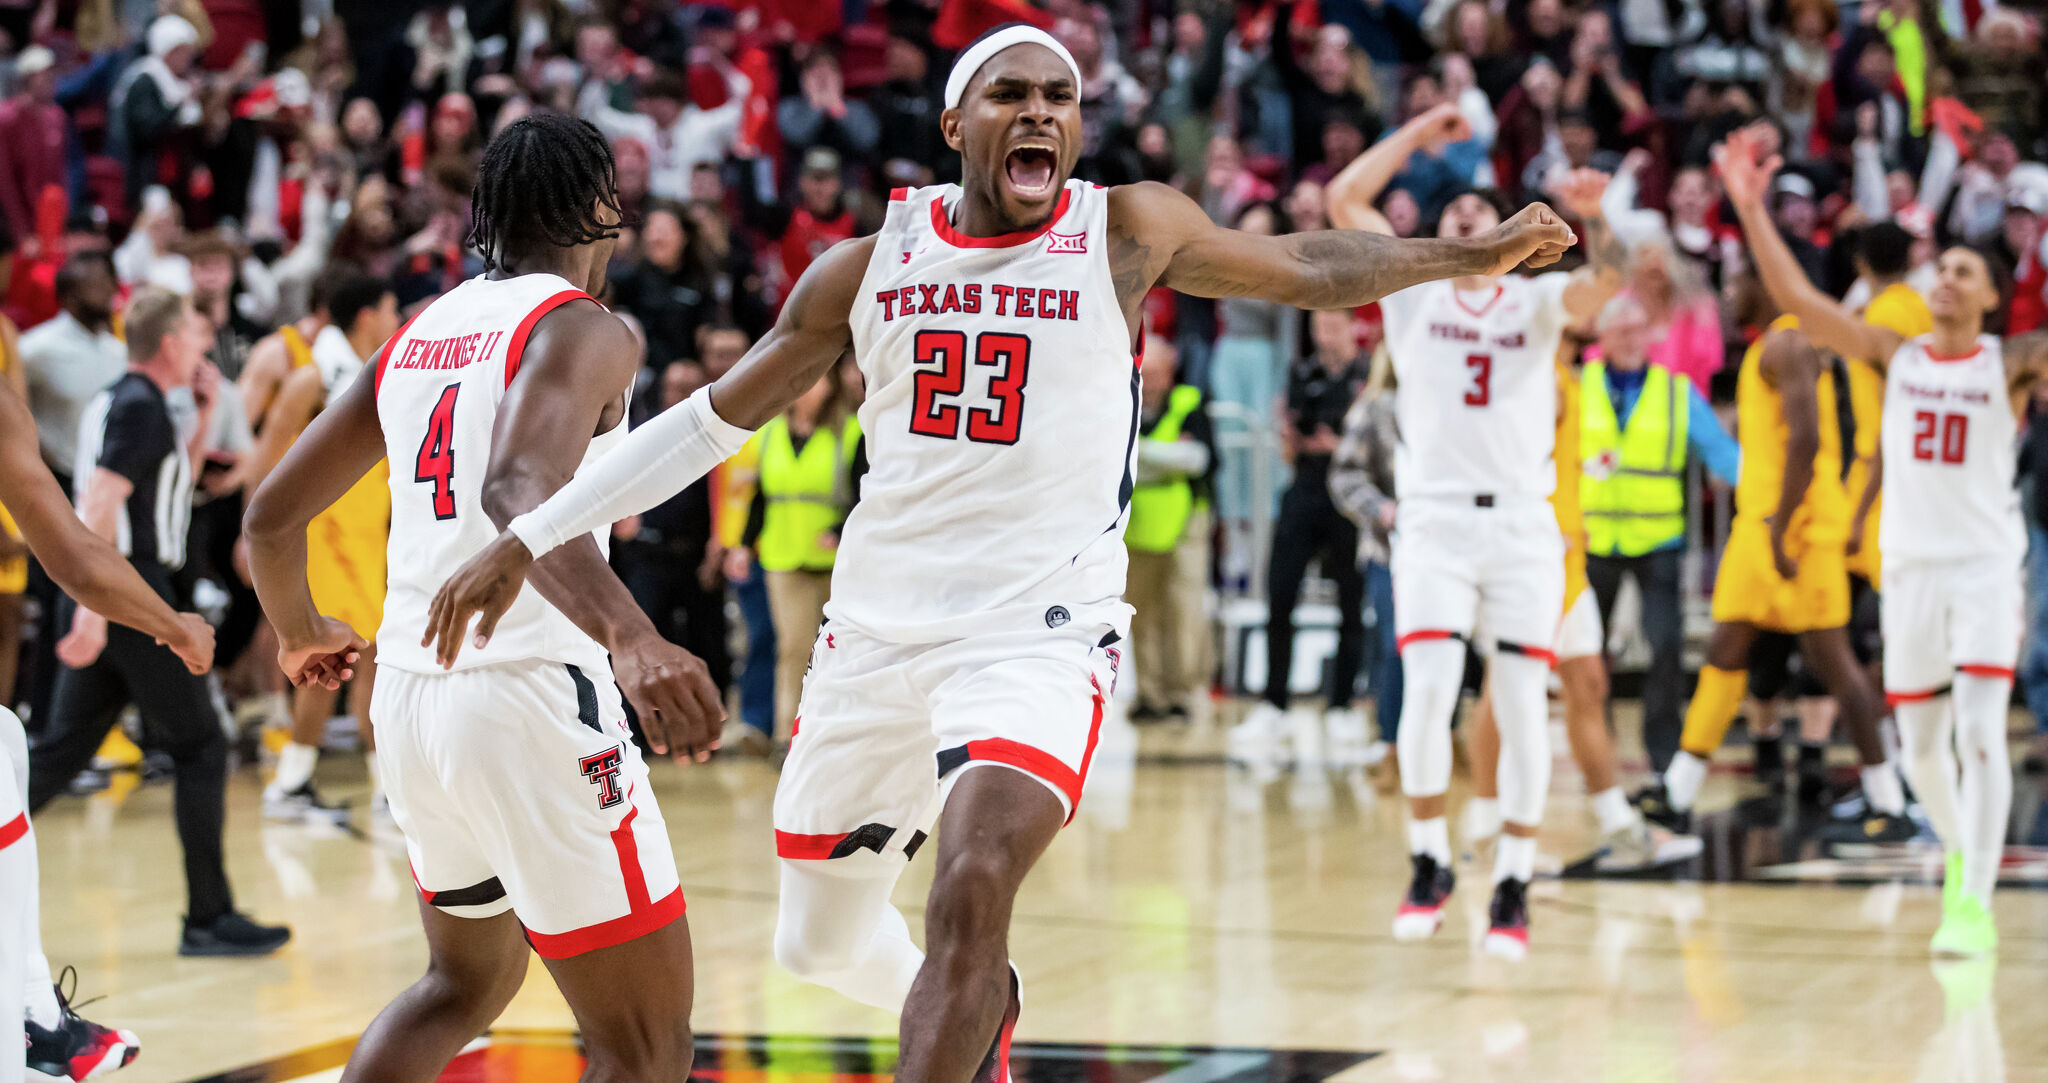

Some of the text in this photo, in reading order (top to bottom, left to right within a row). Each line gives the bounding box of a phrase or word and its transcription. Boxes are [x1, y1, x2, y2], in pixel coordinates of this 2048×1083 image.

[876, 283, 1080, 322] TEXAS TECH
[393, 331, 504, 370] JENNINGS II
[908, 329, 1032, 446] 23
[1464, 353, 1492, 407] 3
[414, 381, 461, 521] 4
[1914, 409, 1969, 465] 20
